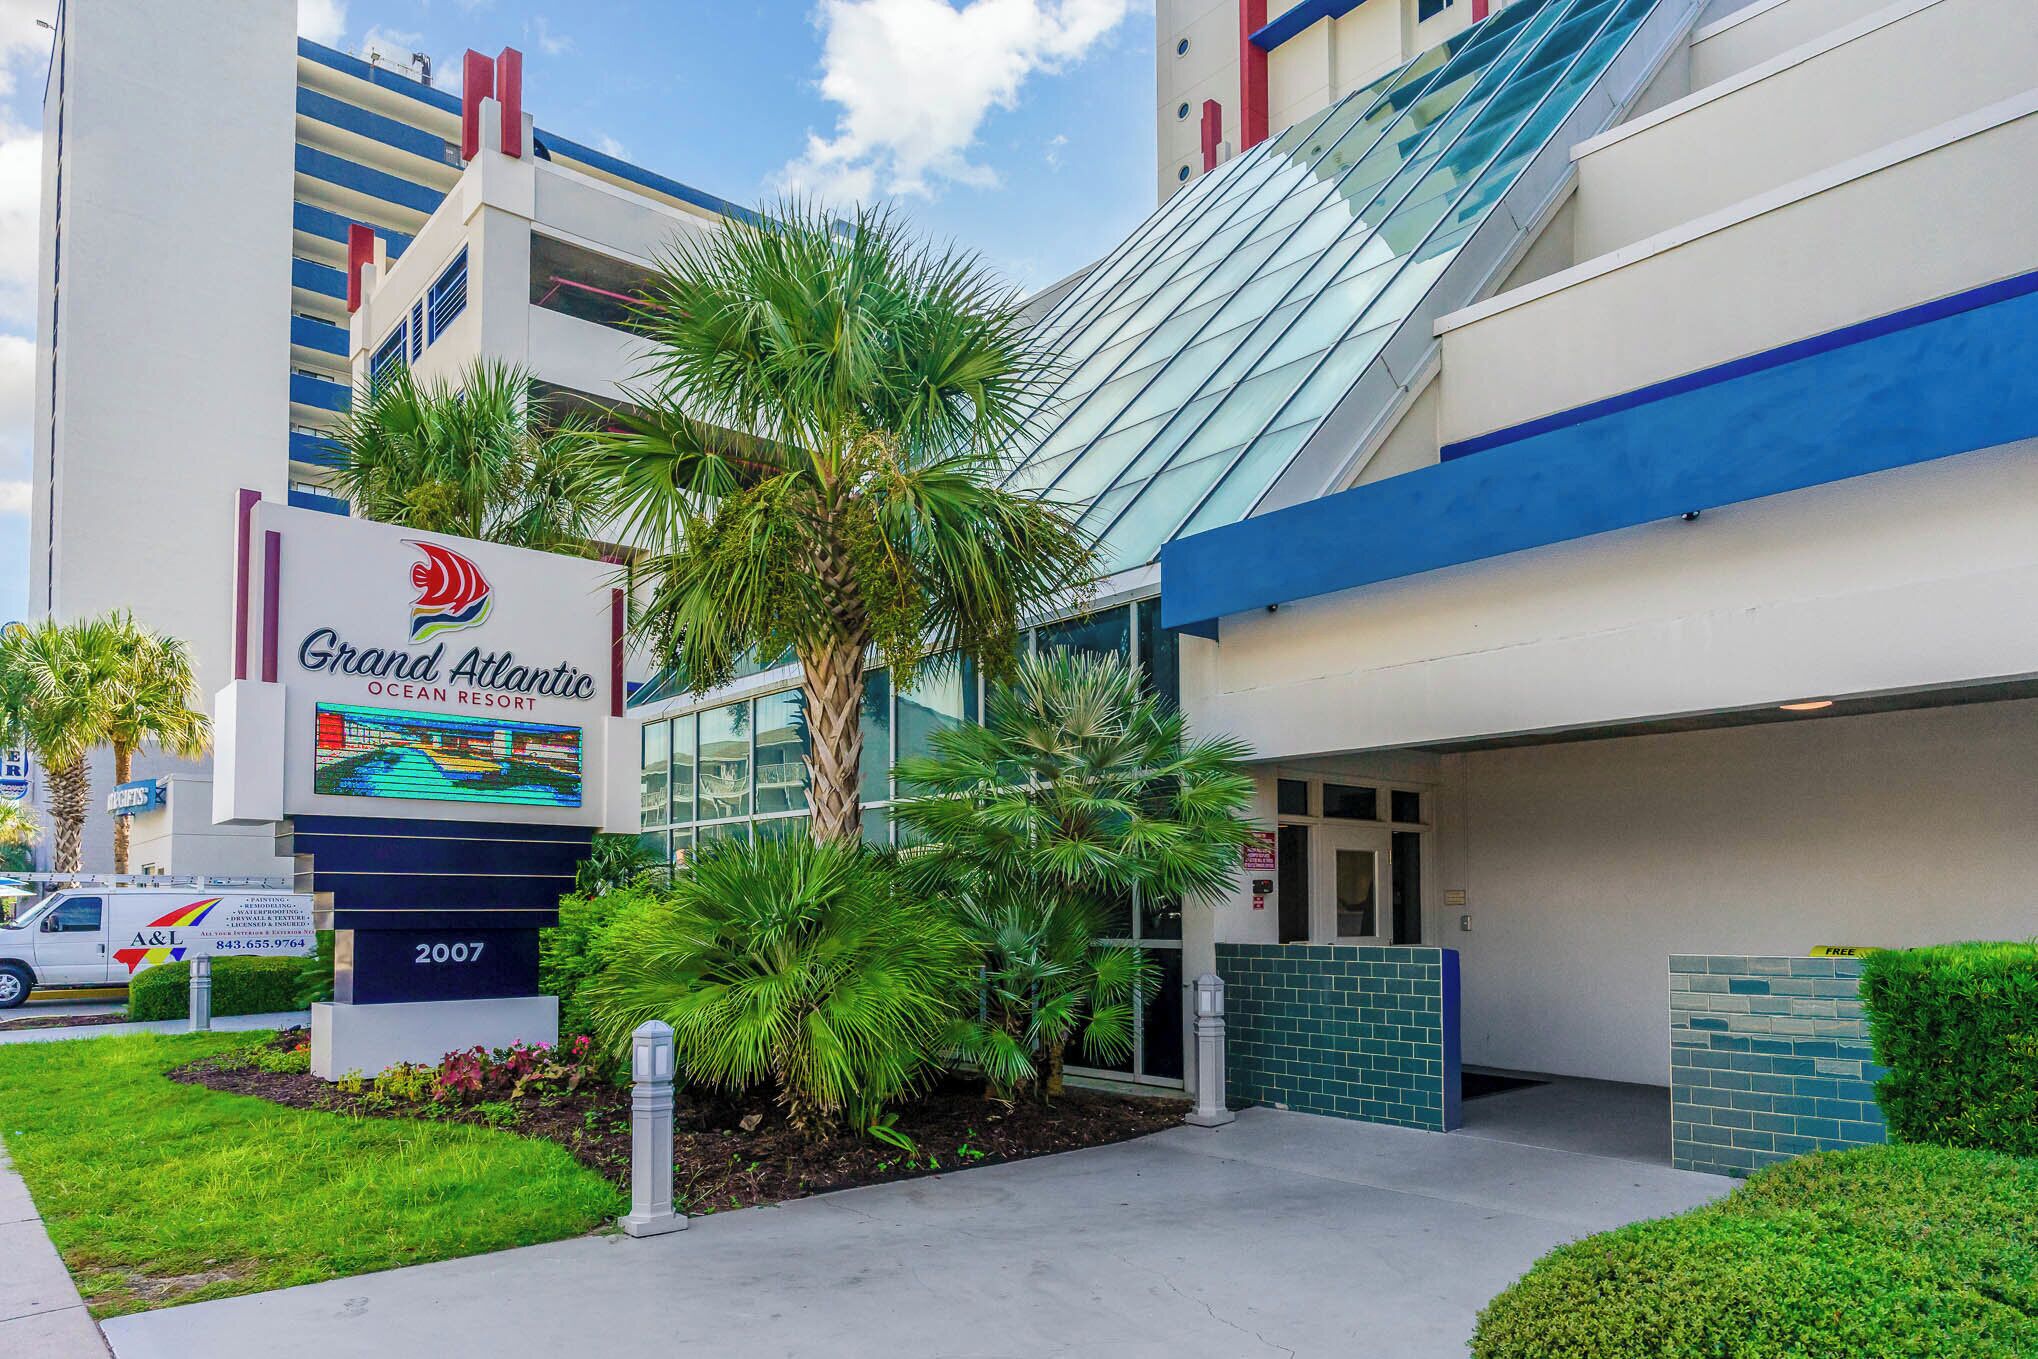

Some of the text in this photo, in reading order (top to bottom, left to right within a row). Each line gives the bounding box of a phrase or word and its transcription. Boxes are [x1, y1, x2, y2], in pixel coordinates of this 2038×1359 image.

[300, 627, 596, 699] Grand Atlantic
[367, 681, 536, 711] OCEAN RESORT
[131, 930, 184, 947] A&L
[216, 938, 305, 950] 843.655.9764
[415, 942, 484, 963] 2007
[1825, 947, 1856, 956] FREE
